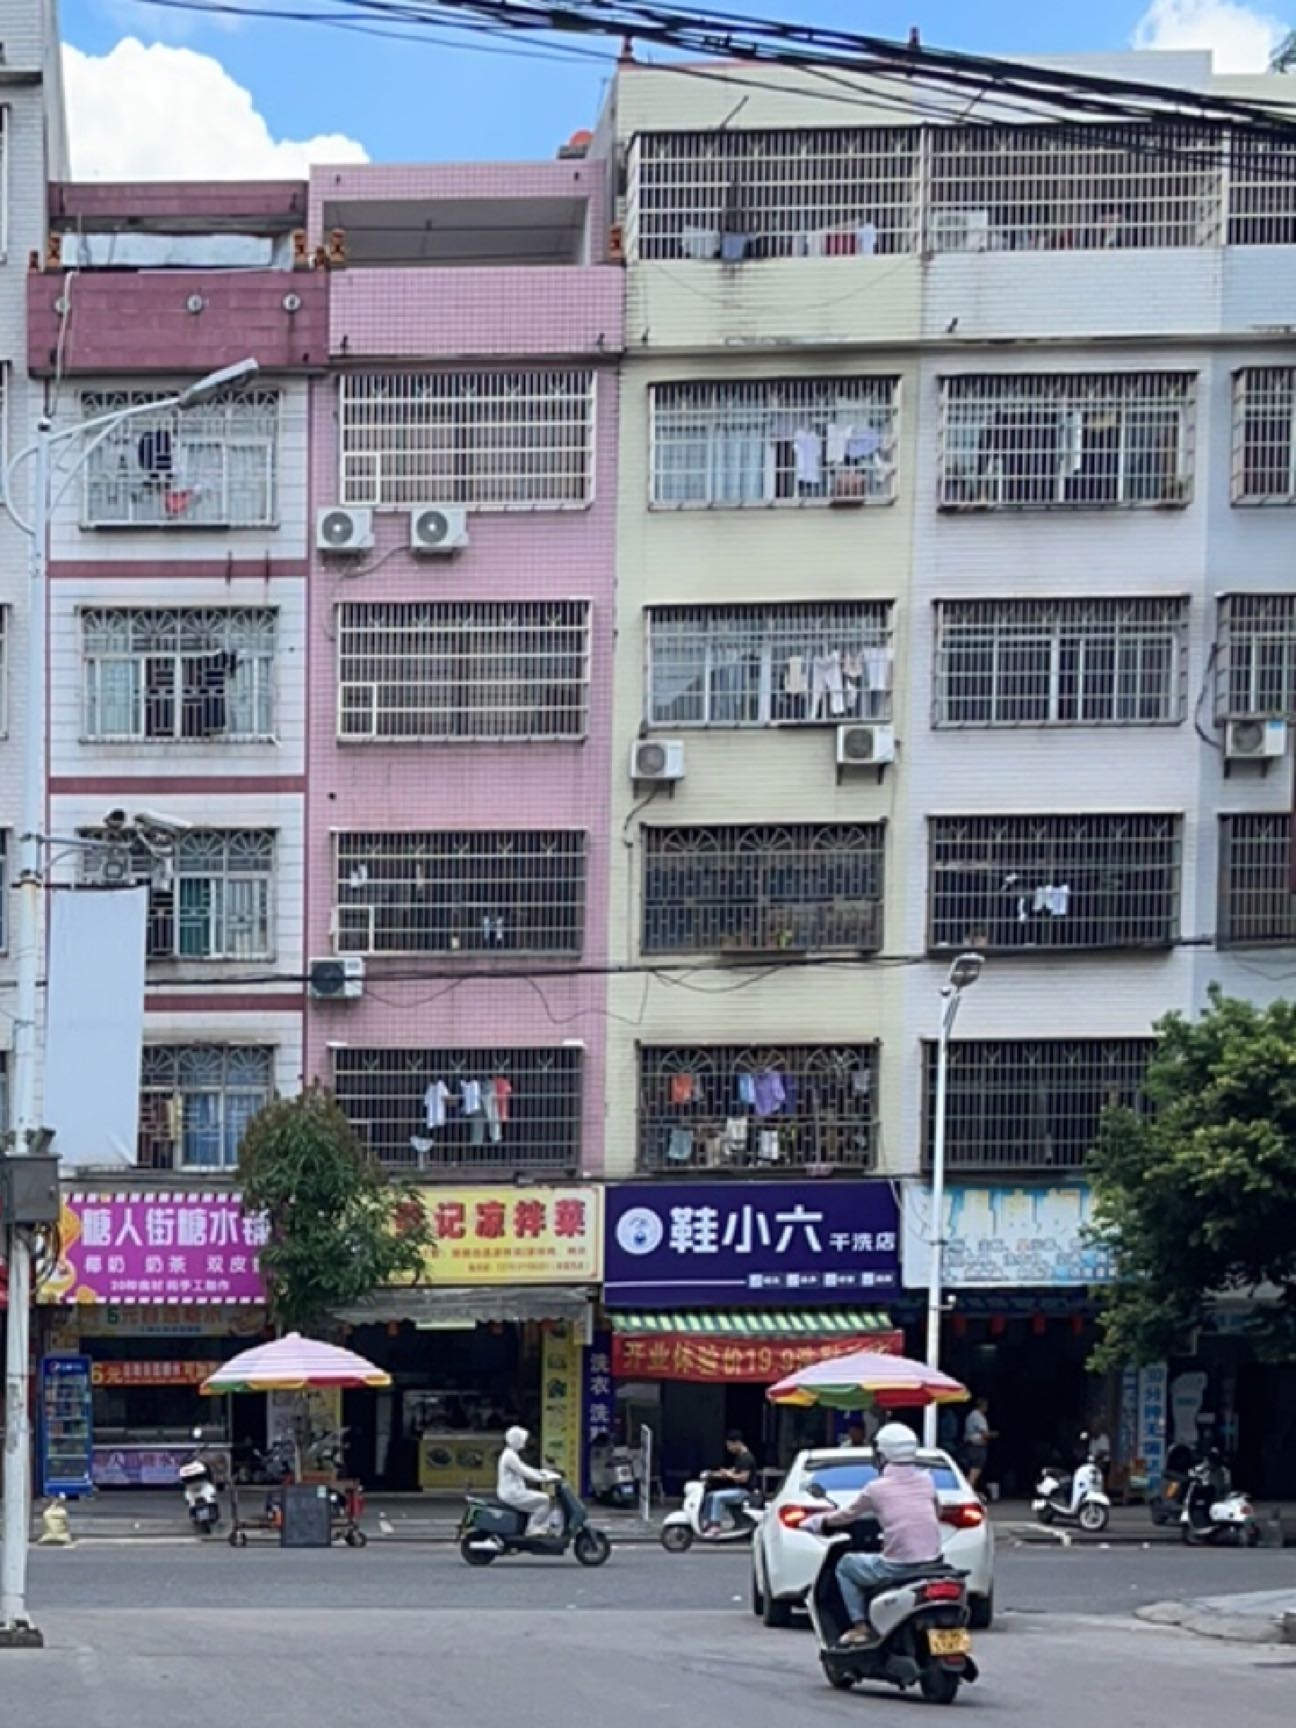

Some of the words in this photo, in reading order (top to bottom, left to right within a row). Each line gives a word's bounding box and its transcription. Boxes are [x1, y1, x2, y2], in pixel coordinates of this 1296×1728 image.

[669, 1204, 823, 1253] 鞋小六
[829, 1232, 896, 1252] 干洗店
[145, 1254, 186, 1274] 奶茶
[207, 1254, 260, 1274] 双皮
